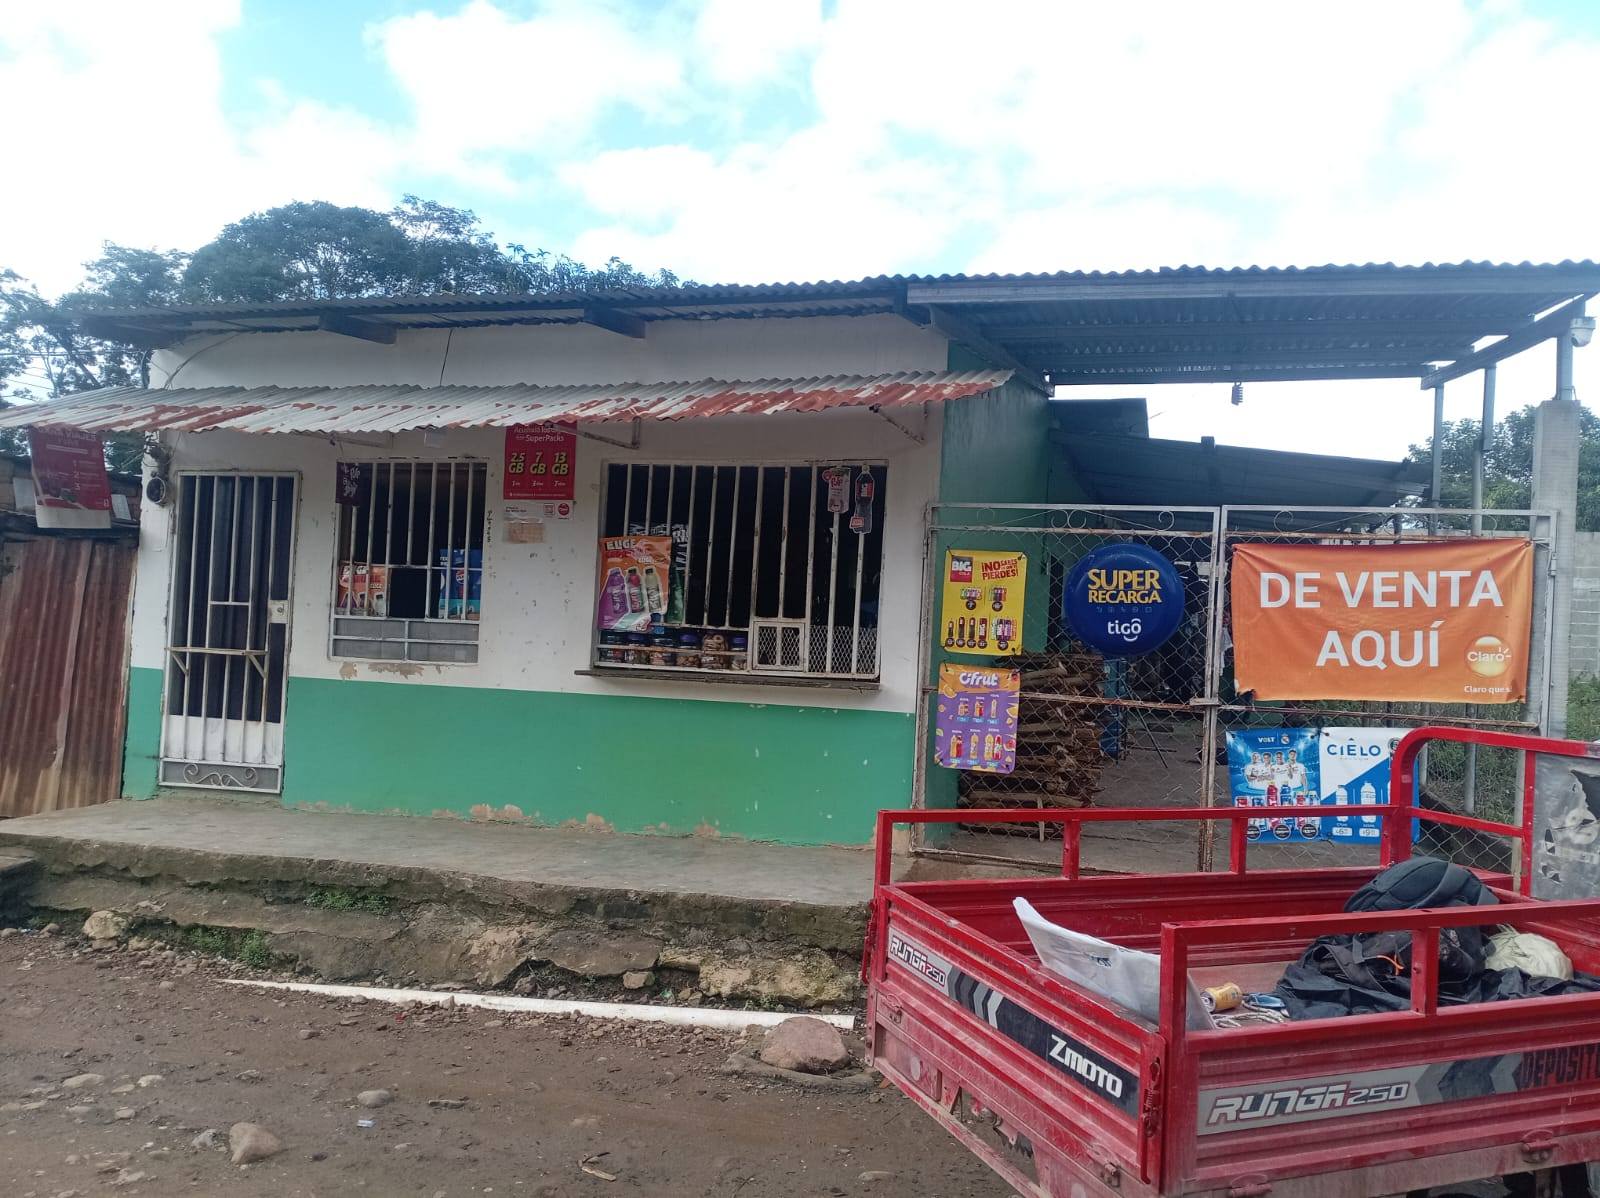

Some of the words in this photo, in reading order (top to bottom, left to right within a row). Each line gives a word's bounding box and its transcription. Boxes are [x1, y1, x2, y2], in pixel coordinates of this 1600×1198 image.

[535, 452, 542, 463] 7
[554, 451, 567, 463] 13
[508, 462, 524, 473] GB
[530, 463, 546, 474] GB
[551, 463, 569, 475] GB
[951, 560, 972, 571] BIG
[1088, 569, 1162, 590] SUPER
[1260, 572, 1321, 609] DE
[1336, 570, 1504, 609] VENTA
[1088, 590, 1163, 604] RECARGA
[1316, 620, 1445, 670] AQUÍ
[1467, 648, 1508, 662] Claro
[959, 671, 999, 686] Cifrut
[1464, 685, 1487, 693] Claro
[926, 962, 946, 987] 250
[1346, 1082, 1411, 1107] 250
